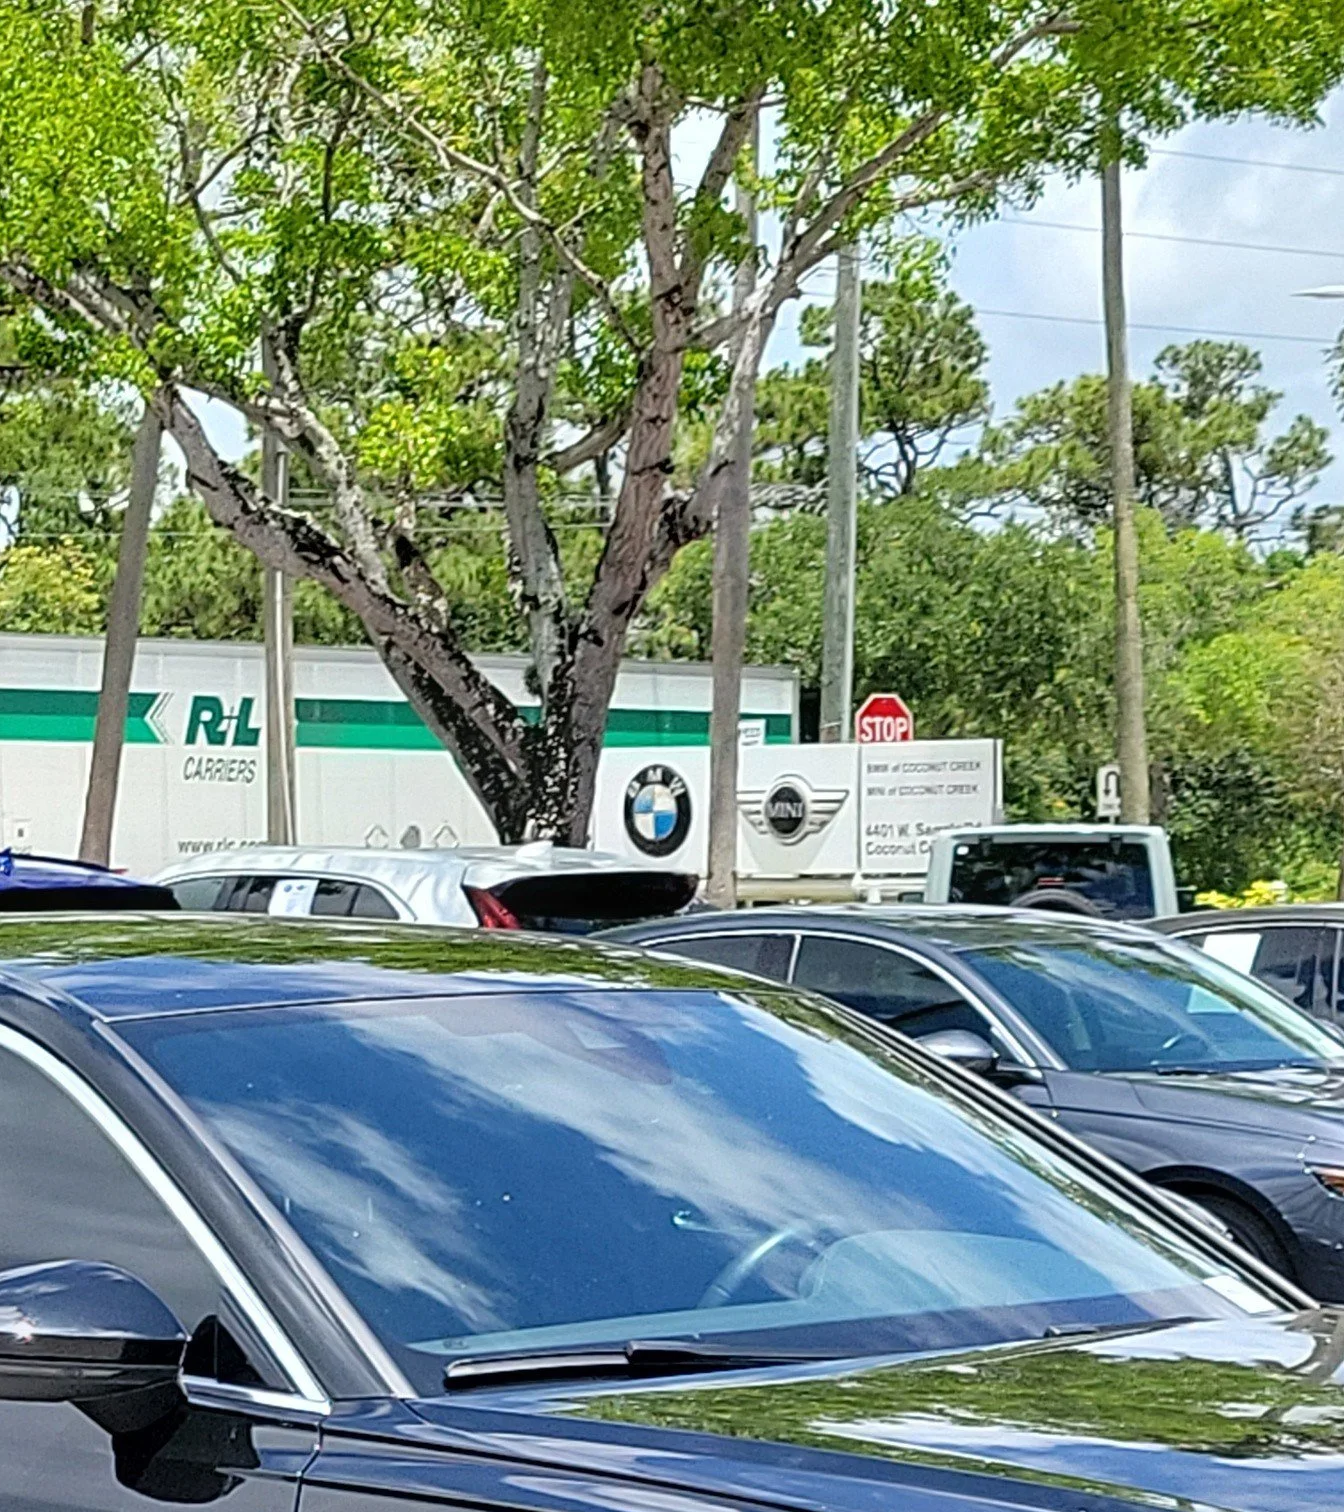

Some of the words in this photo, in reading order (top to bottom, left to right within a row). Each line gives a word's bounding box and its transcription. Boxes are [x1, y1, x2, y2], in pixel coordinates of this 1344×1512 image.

[860, 715, 908, 742] STOP
[183, 755, 257, 784] CARRIERS
[627, 767, 686, 798] BMW
[767, 802, 805, 818] MINI
[865, 823, 895, 837] 4401
[865, 841, 916, 856] Coconut
